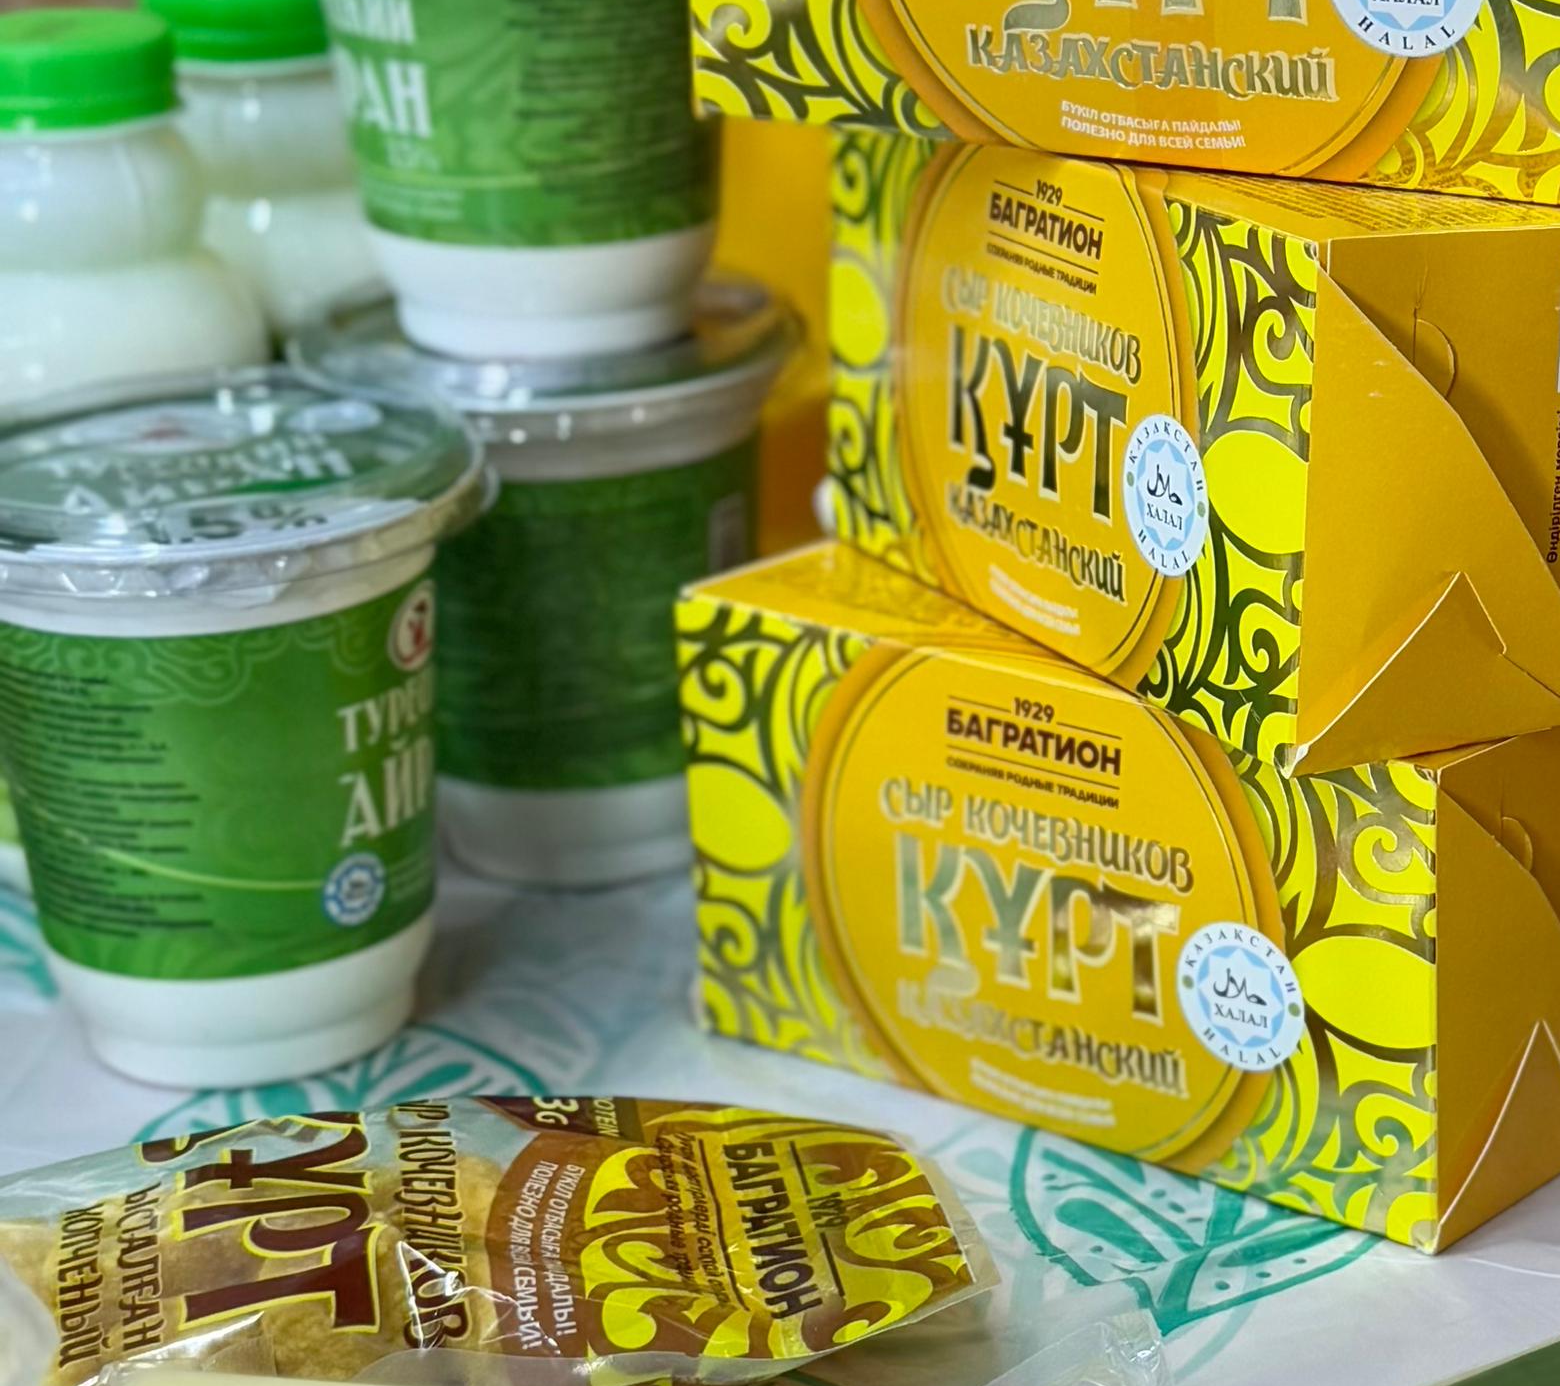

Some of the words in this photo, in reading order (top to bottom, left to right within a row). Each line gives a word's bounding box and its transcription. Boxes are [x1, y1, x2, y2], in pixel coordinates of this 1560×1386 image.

[965, 23, 1340, 102] КАЗАХСТАНСКИЙ
[1357, 15, 1455, 50] HALAL
[1061, 116, 1126, 143] ПОЛЕЗНО
[1127, 130, 1157, 148] ДЛЯ
[1158, 132, 1193, 150] ВСЕЙ
[1195, 134, 1246, 150] СЕМЬИ!
[1036, 179, 1062, 206] 1929
[990, 192, 1103, 260] БАГРАТИОН
[1014, 697, 1054, 723] 1929
[947, 708, 1121, 776] БАГРАТИОН
[1057, 783, 1119, 809] ТРАДИЦИИ
[881, 776, 953, 827] СЫР
[963, 793, 1194, 895] КОЧЕВНИКОВ
[1203, 1027, 1281, 1064] HALAL
[1214, 1003, 1268, 1028] ХАЛАЛ
[520, 1160, 559, 1221] ПОЛЕЗНО
[394, 1131, 471, 1350] КОЧЕВНИКОВ
[722, 1141, 824, 1320] БАГРАТИОН
[57, 1203, 113, 1369] КОПЧЕНЫЙ
